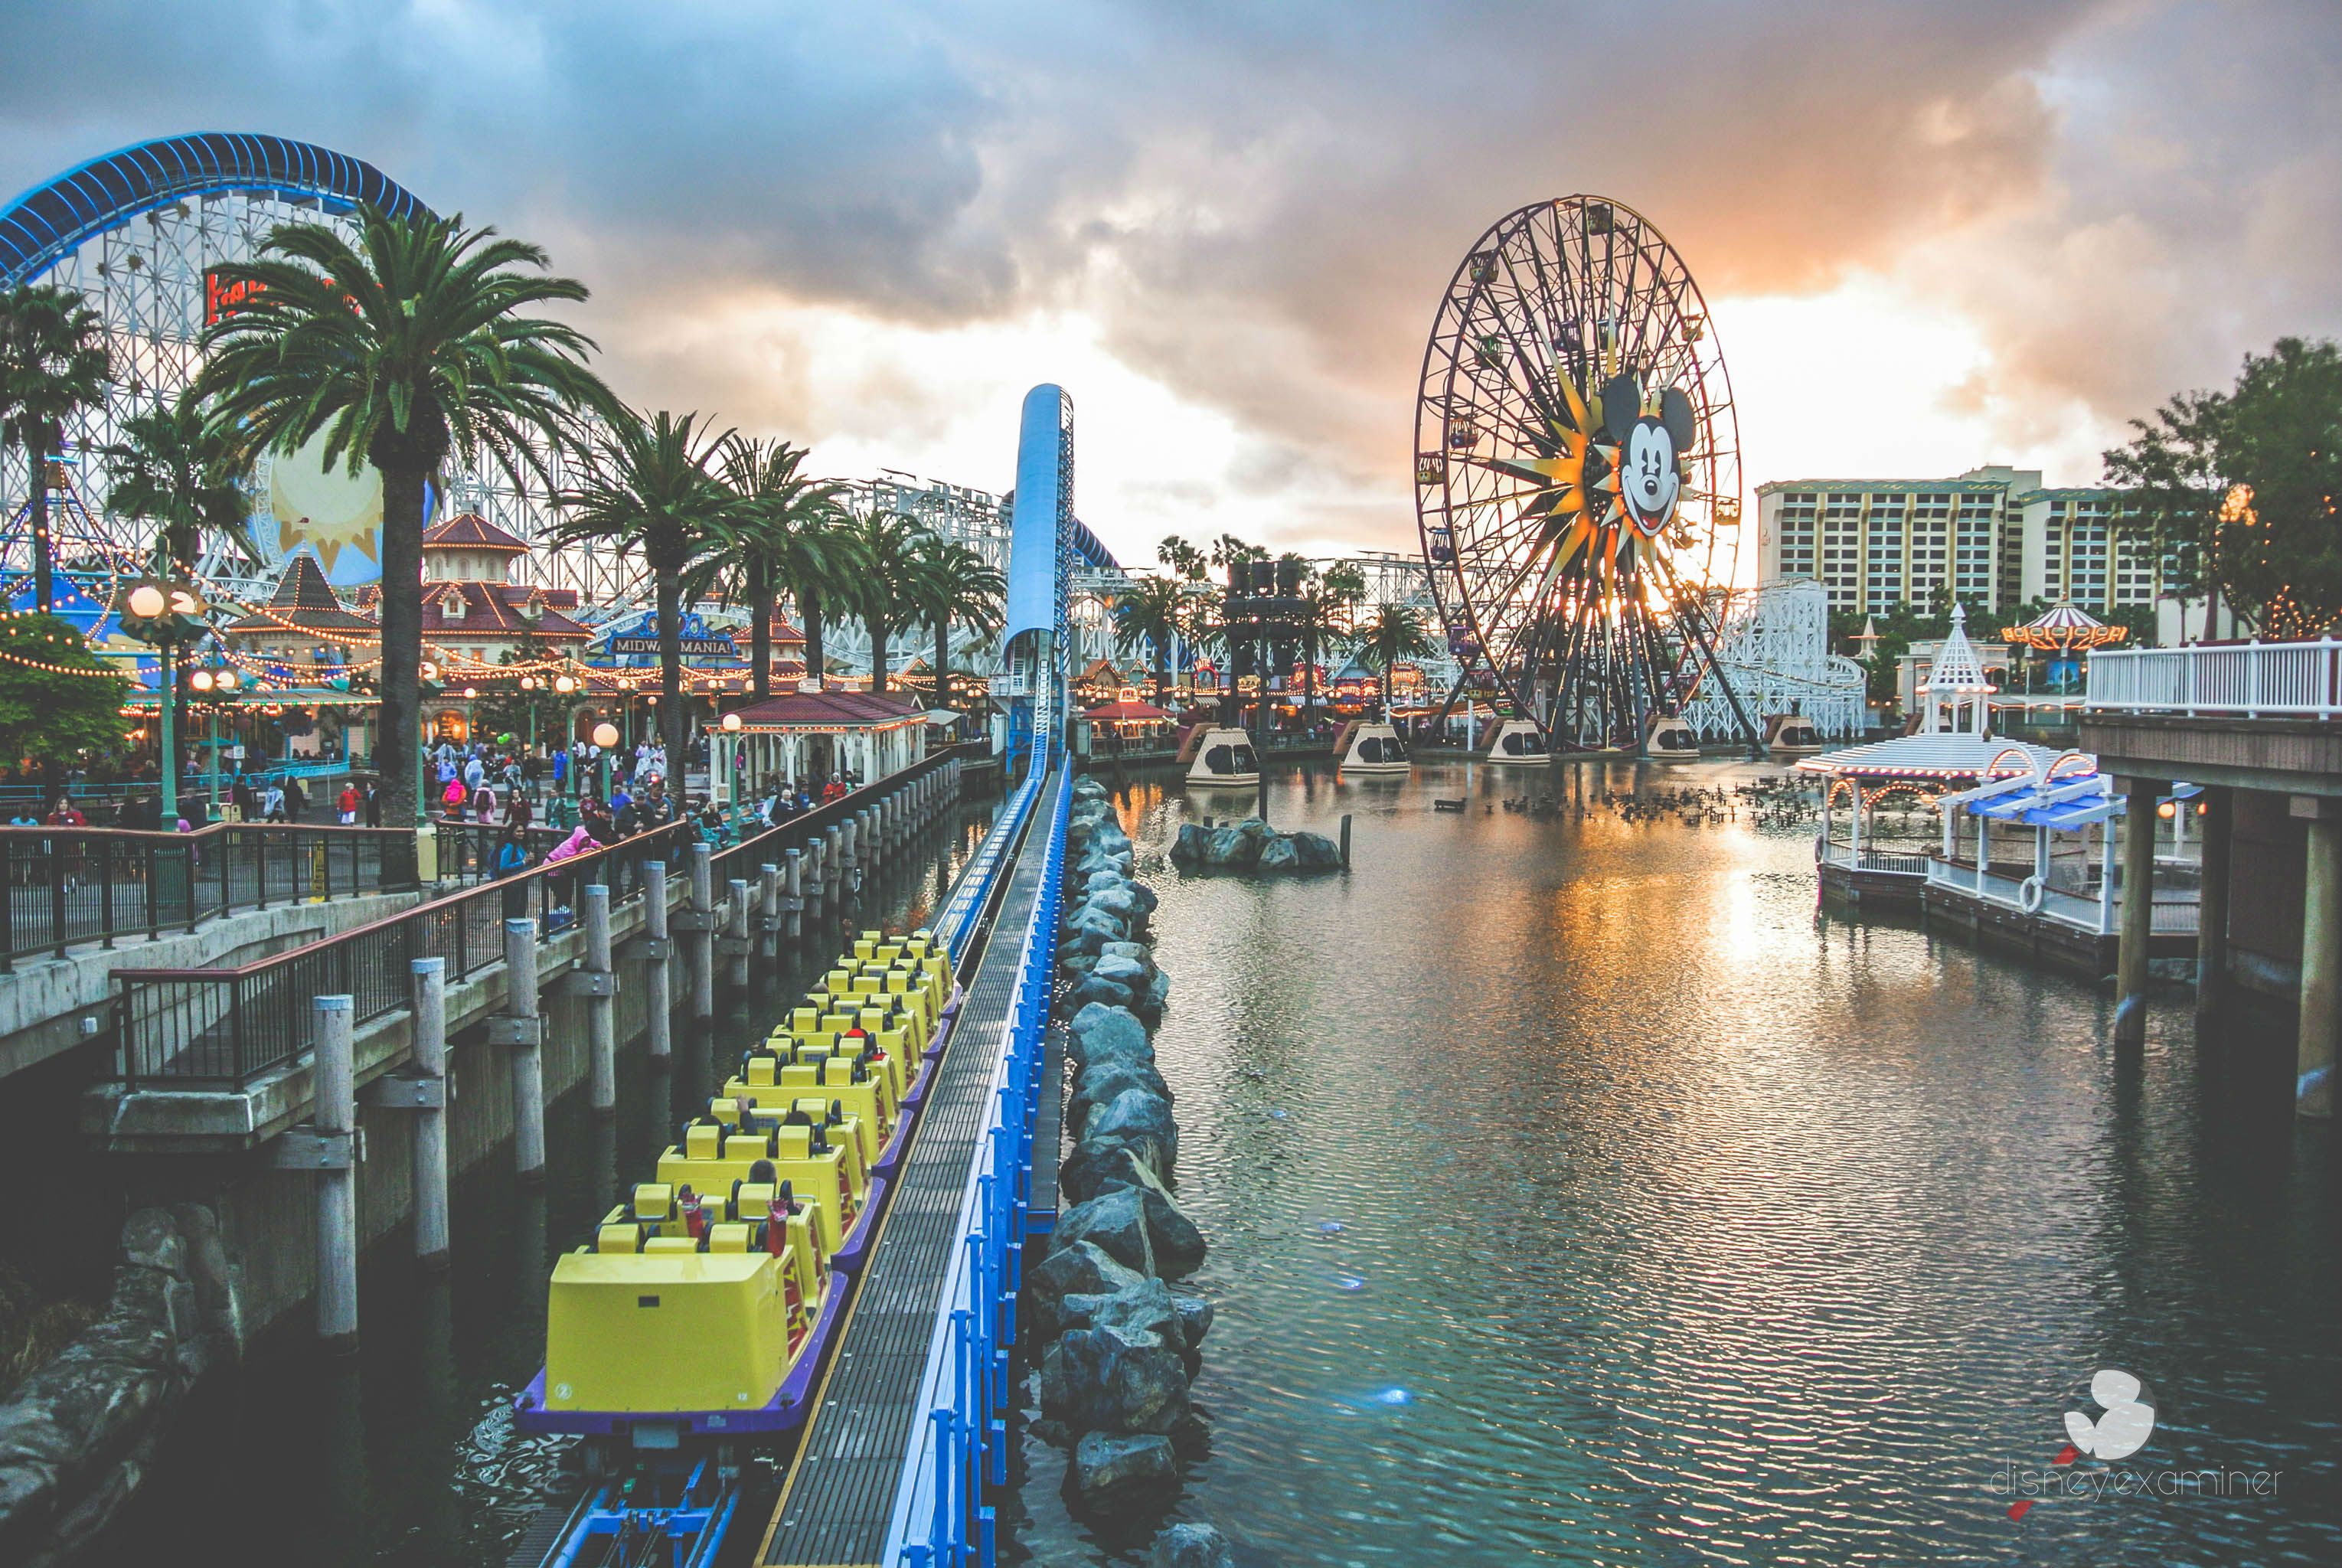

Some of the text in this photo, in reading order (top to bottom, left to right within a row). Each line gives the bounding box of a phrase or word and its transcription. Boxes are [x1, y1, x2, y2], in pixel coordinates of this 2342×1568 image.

[616, 640, 730, 653] MIDW MANIA!
[1295, 671, 1318, 683] SHS
